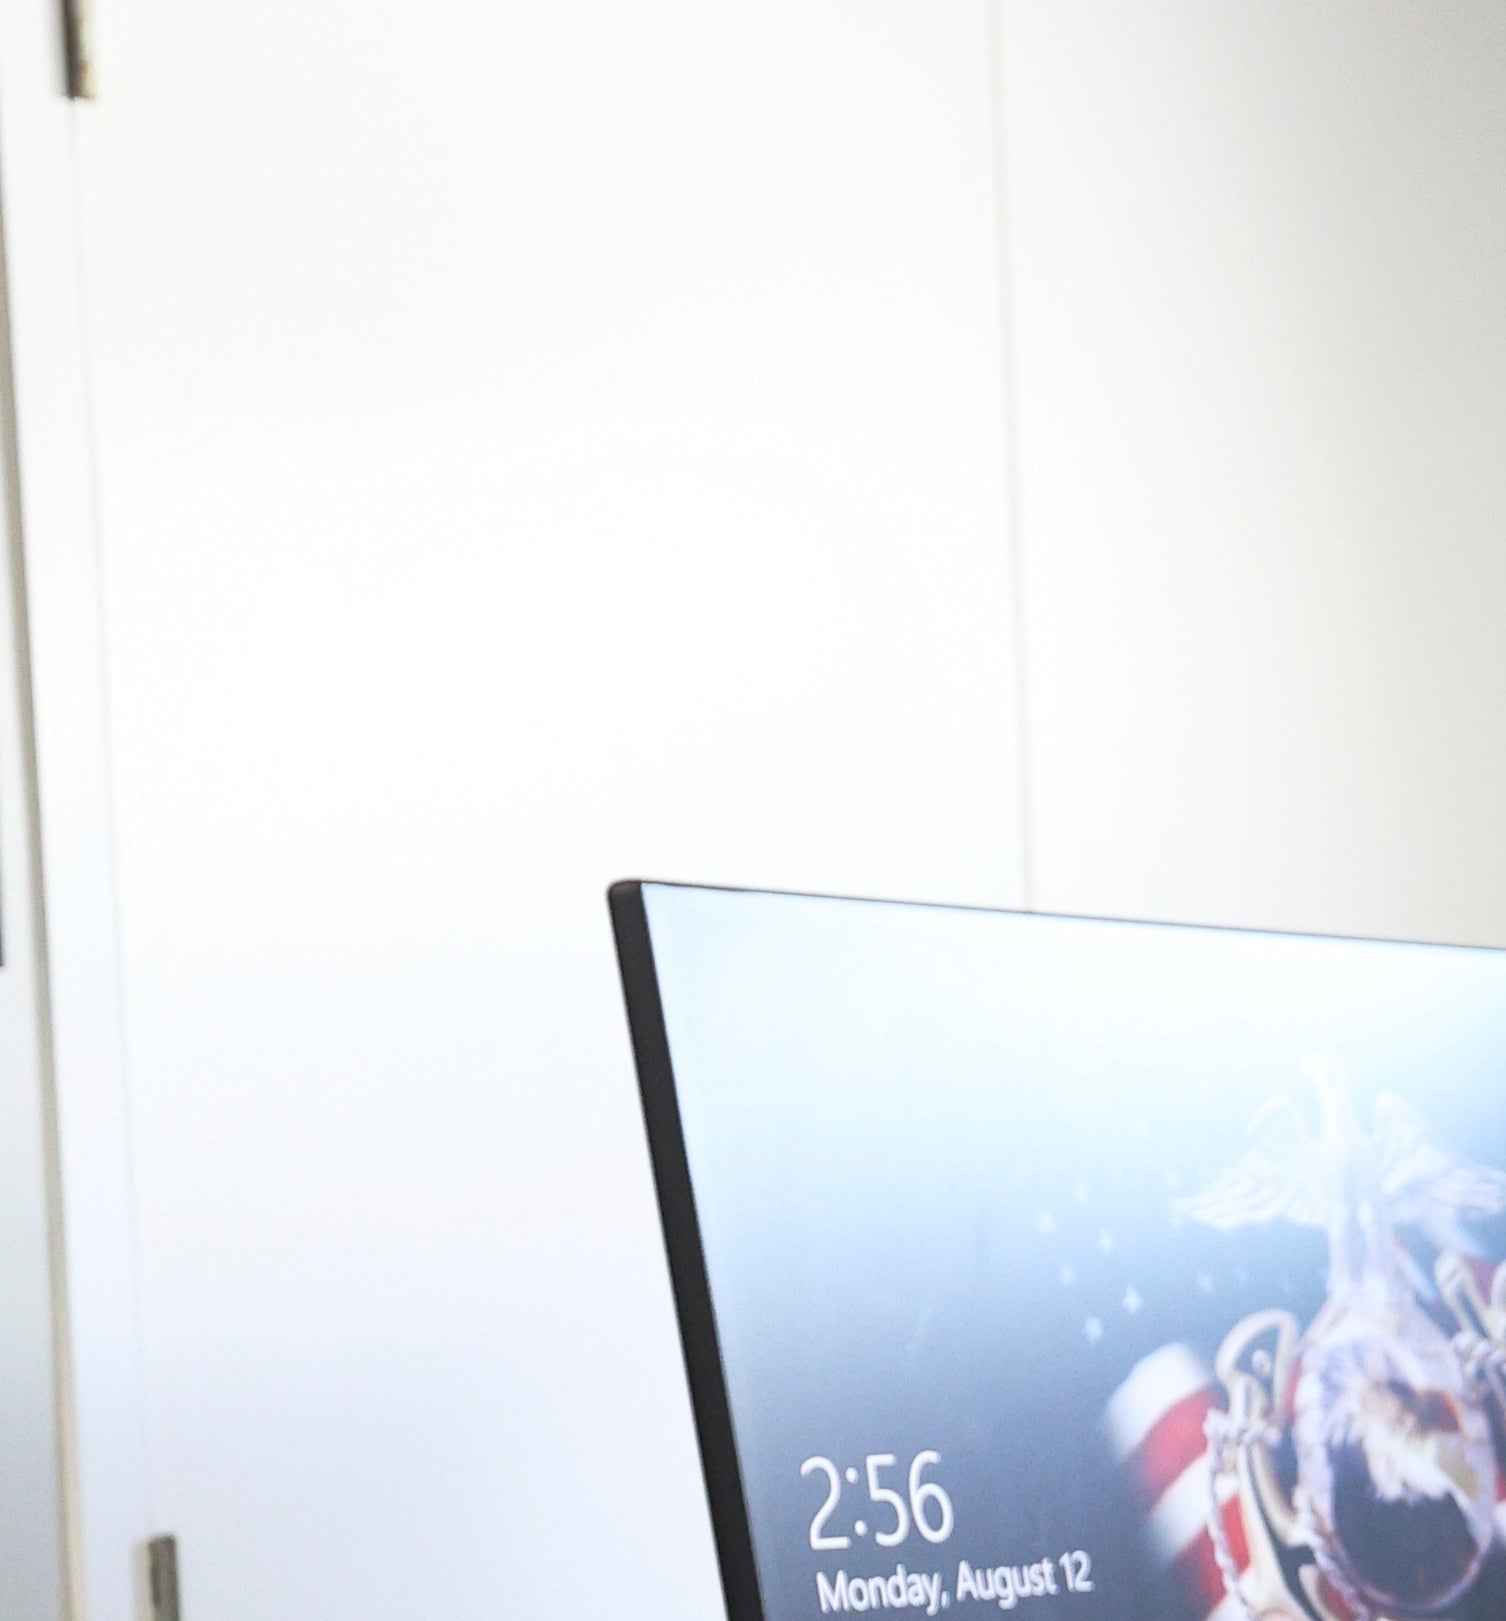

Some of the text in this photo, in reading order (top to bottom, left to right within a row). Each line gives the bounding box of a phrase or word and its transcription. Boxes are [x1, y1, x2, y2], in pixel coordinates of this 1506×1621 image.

[800, 1450, 954, 1550] 2:56
[816, 1550, 1095, 1616] Monday, August 12
